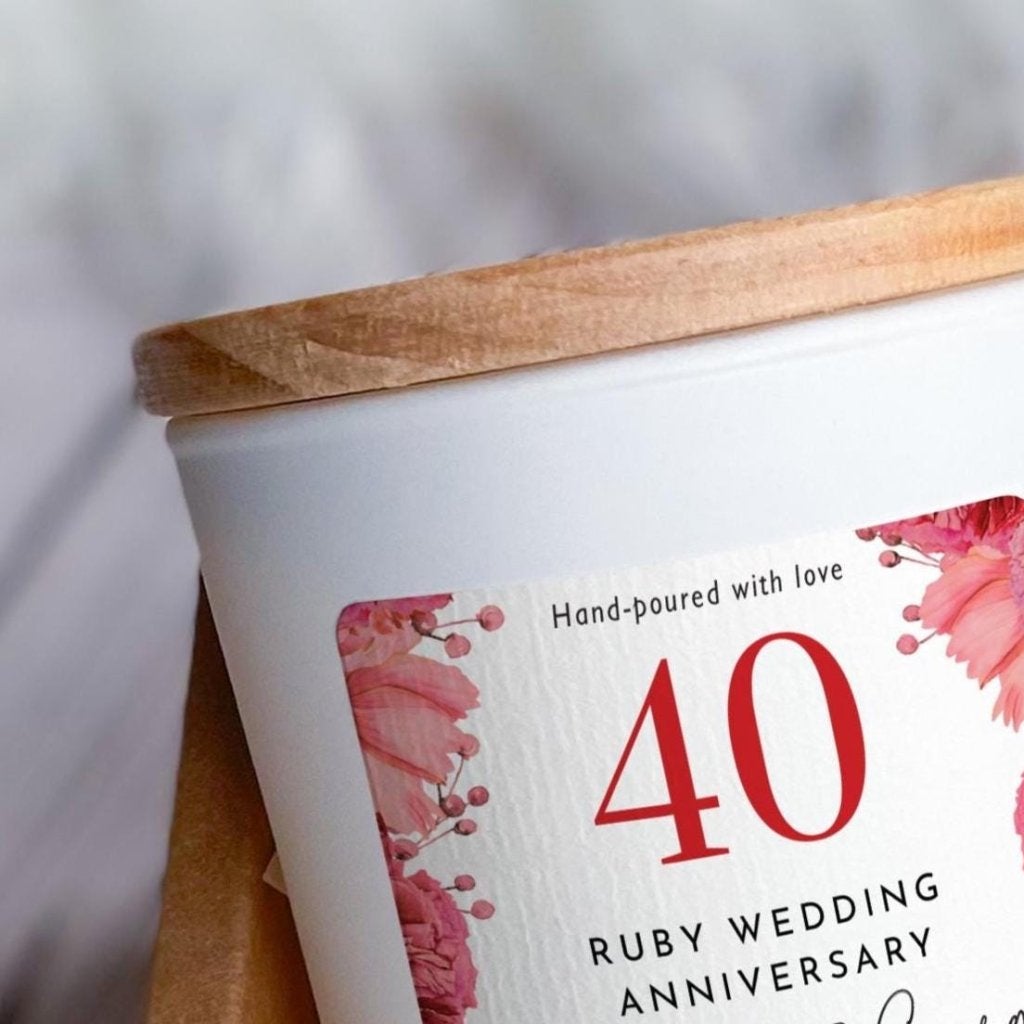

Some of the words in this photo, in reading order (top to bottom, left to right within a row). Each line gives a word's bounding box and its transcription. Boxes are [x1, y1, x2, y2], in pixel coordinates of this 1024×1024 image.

[552, 582, 720, 628] Hand-poured
[732, 572, 783, 601] with
[795, 561, 843, 588] love
[594, 632, 866, 865] 40
[589, 923, 702, 966] RUBY
[729, 872, 939, 943] WEDDING
[620, 928, 931, 1016] ANNIVERSARY
